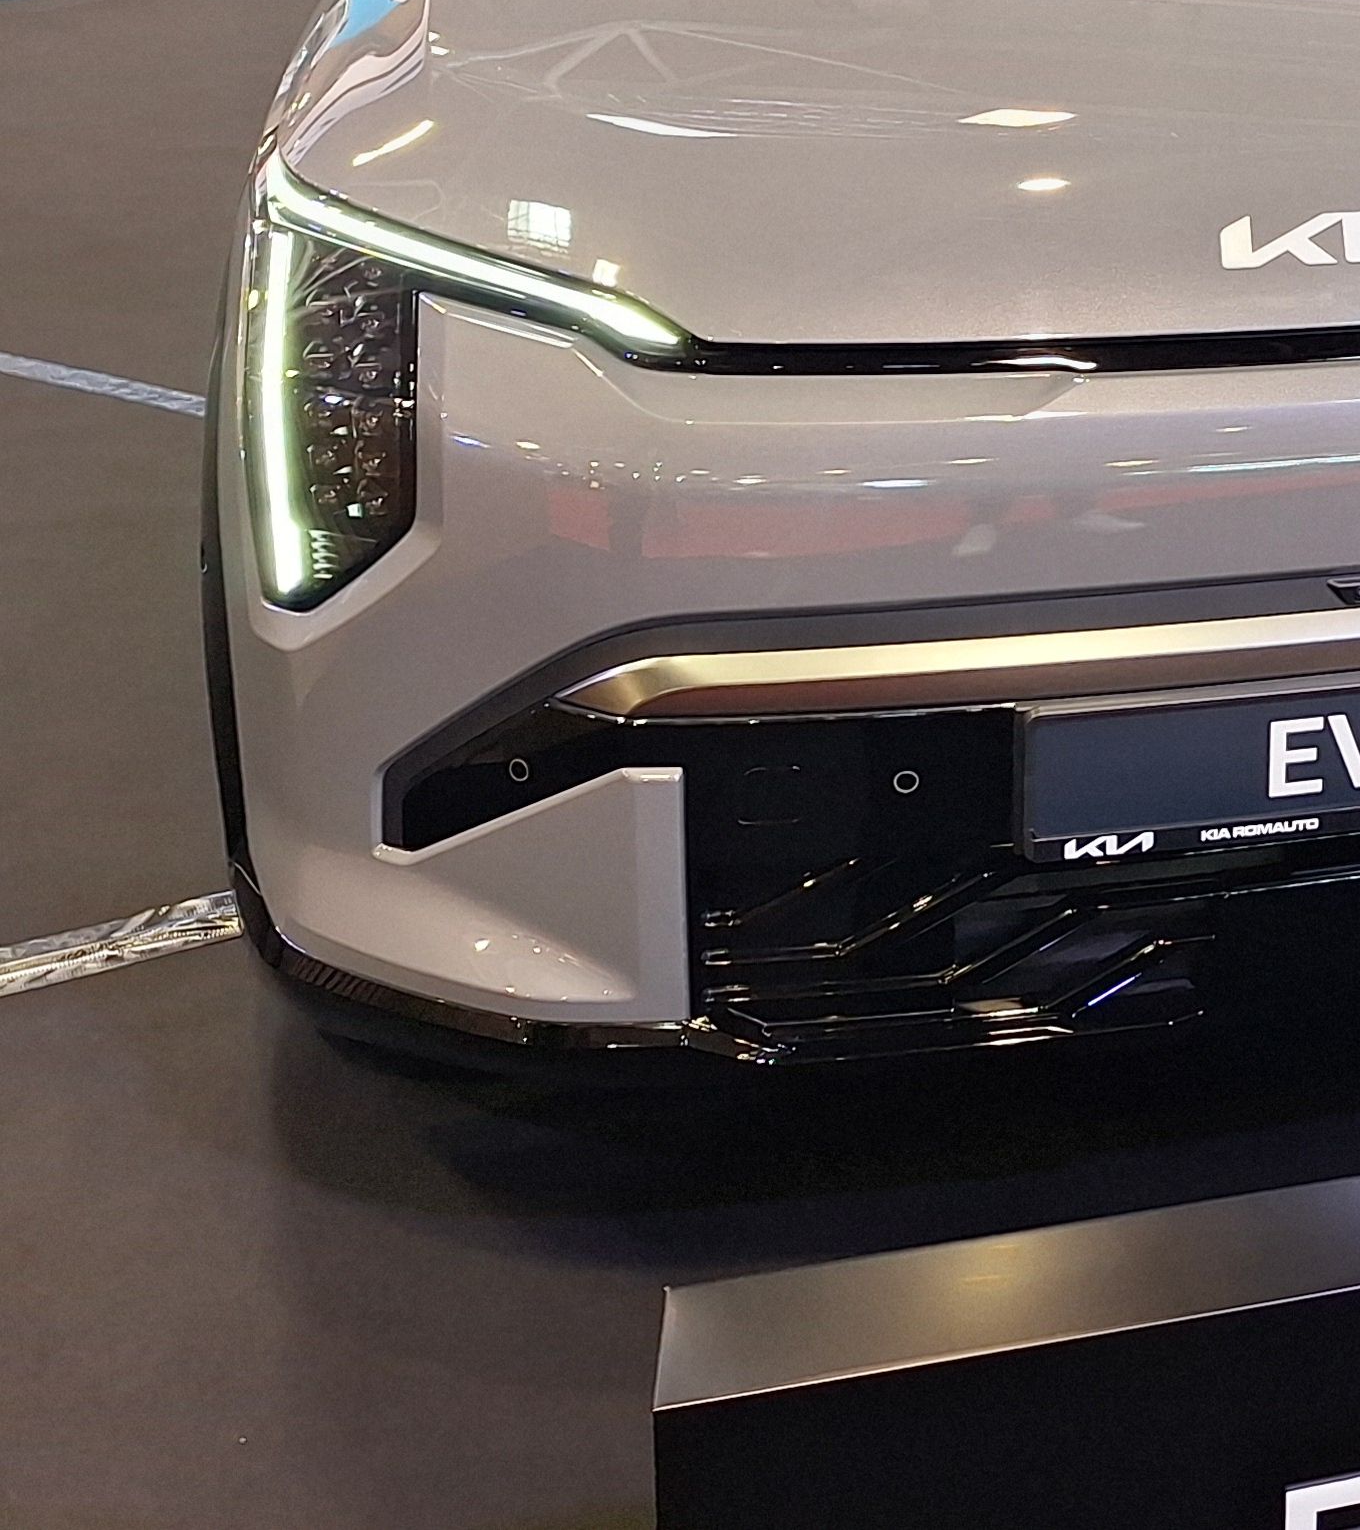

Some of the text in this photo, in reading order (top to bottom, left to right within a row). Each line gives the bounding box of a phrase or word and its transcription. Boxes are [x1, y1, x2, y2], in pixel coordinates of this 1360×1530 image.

[1201, 818, 1319, 841] KIA ROMAUTO
[1063, 832, 1154, 860] KIA
